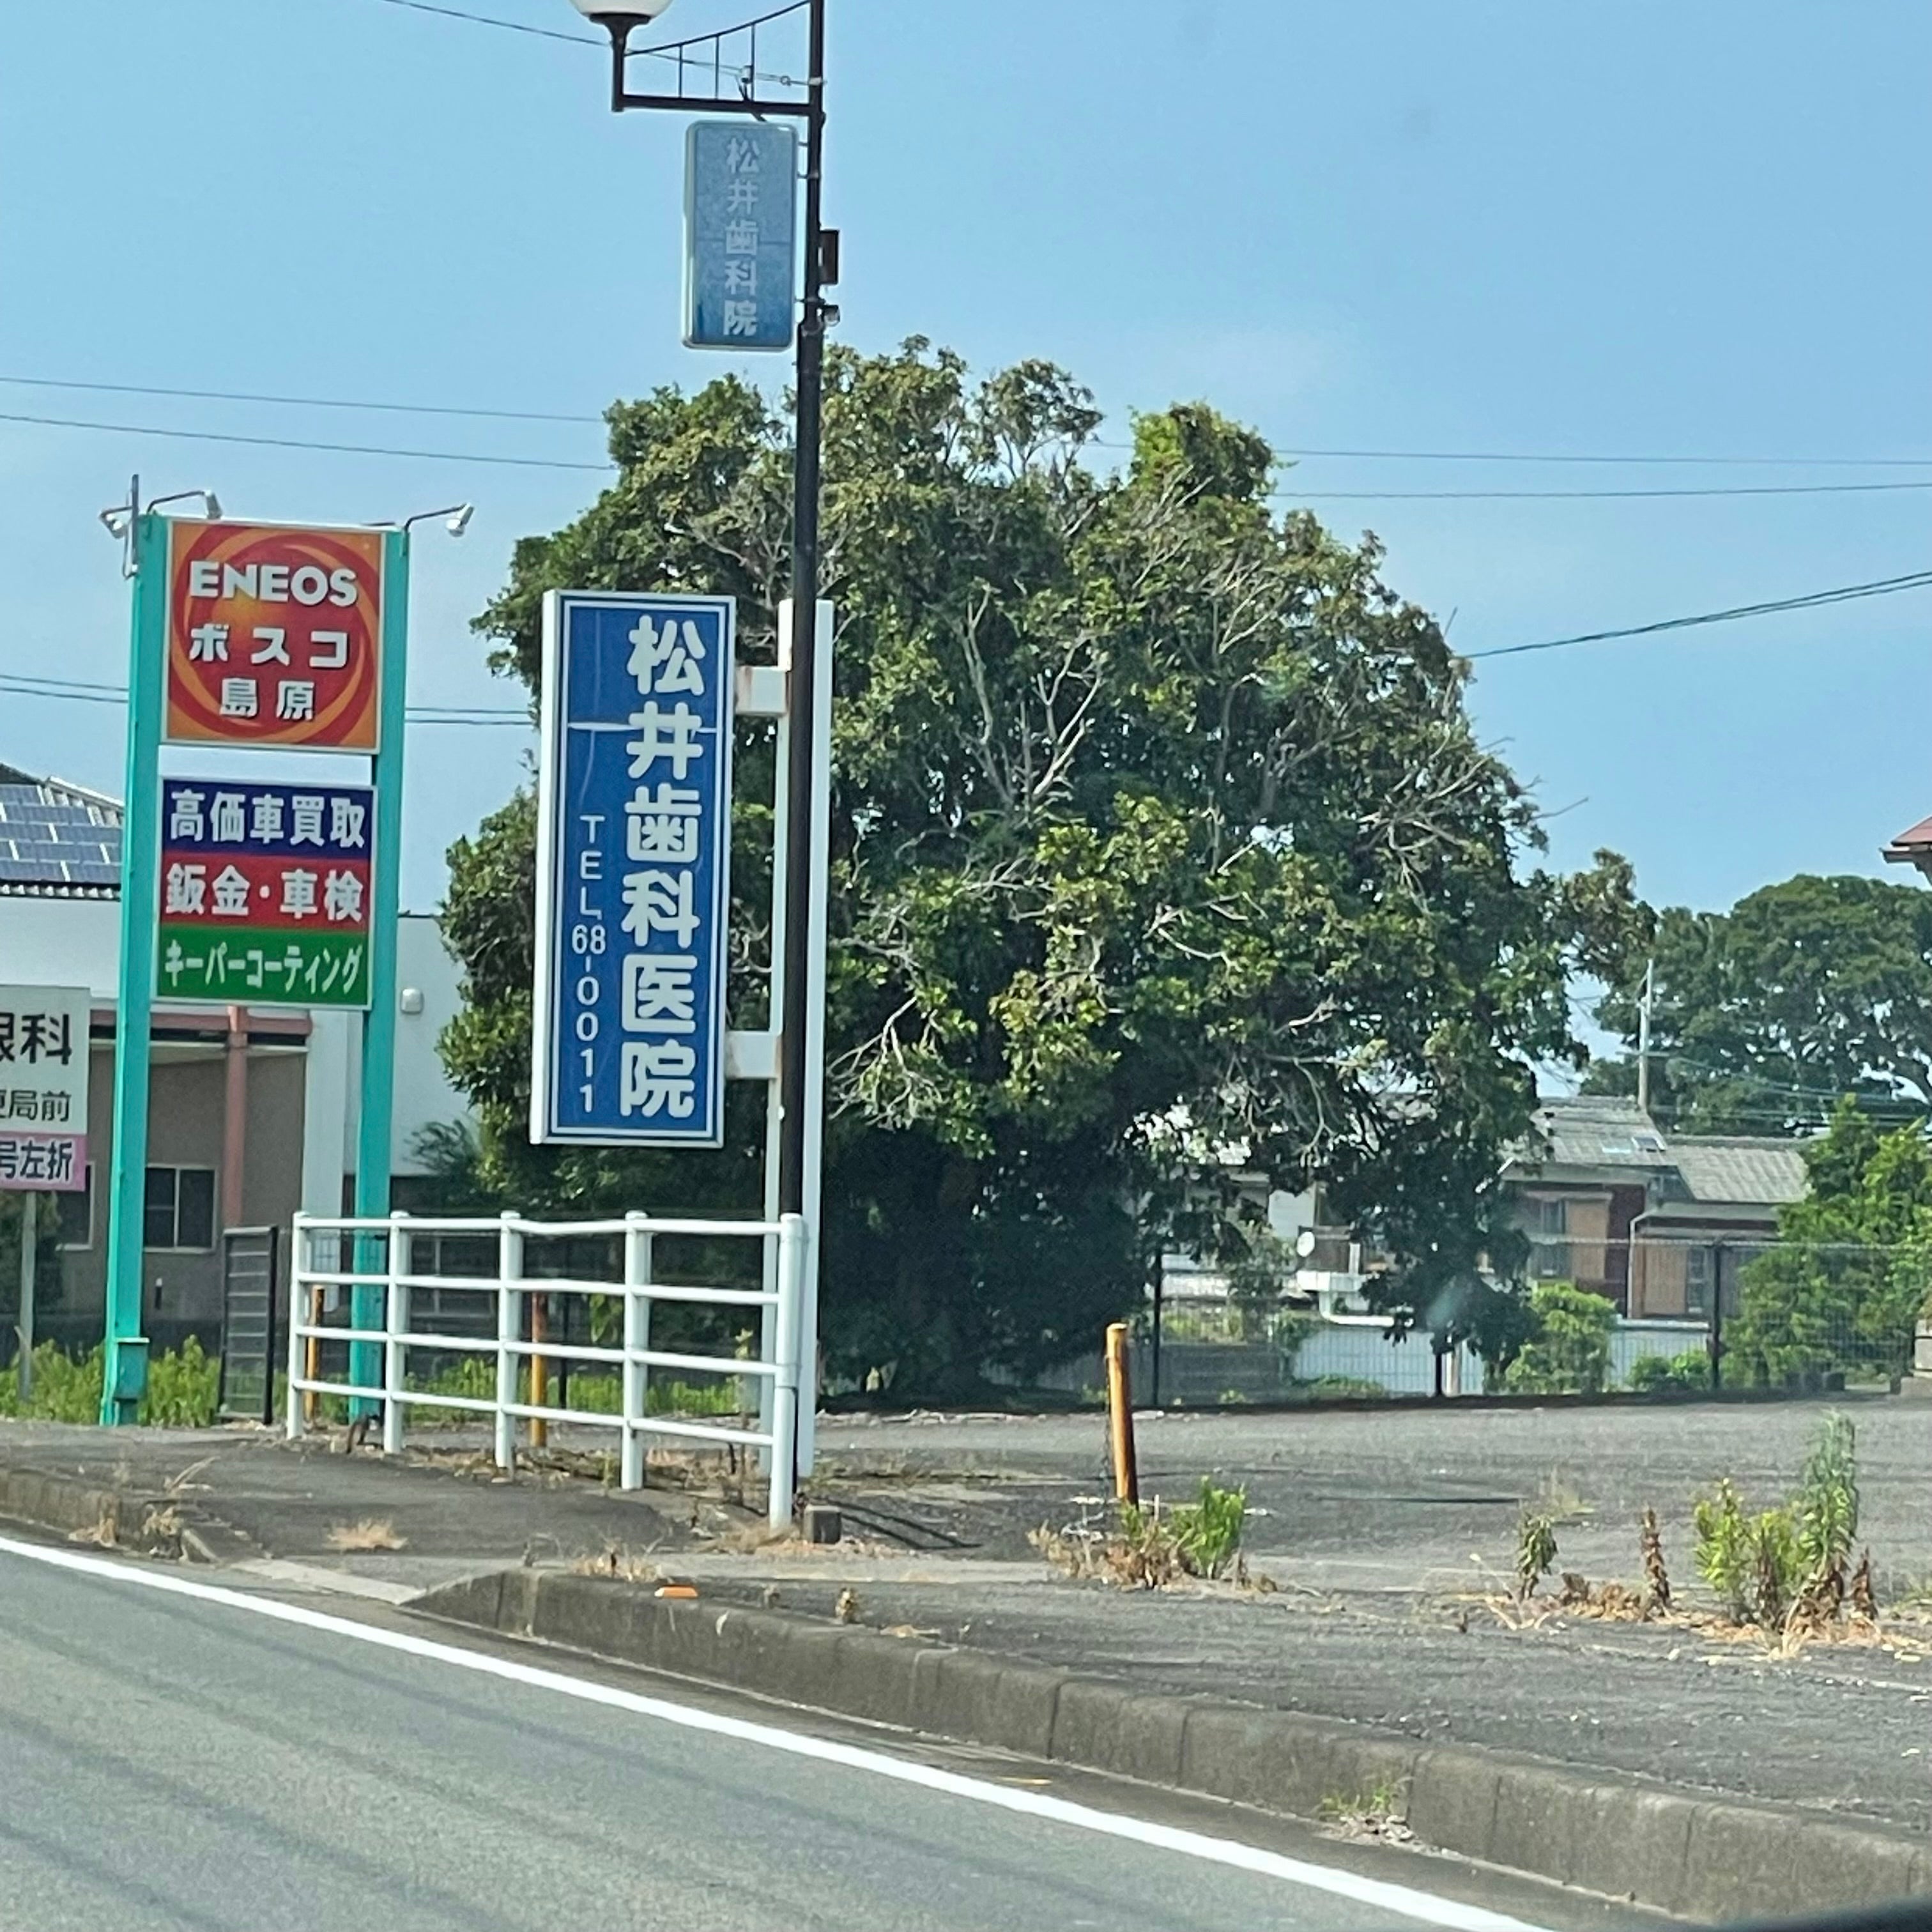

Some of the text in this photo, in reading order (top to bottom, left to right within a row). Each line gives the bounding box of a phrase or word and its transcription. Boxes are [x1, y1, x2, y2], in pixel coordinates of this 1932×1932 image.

[723, 137, 760, 337] 松井歯科院
[190, 560, 358, 607] ENEOS
[189, 623, 349, 668] ボスコ
[219, 677, 315, 721] 島原
[170, 788, 365, 848] 高価車買取
[619, 615, 705, 1118] 松井歯科医院
[164, 939, 363, 994] キーパーコーティング
[0, 1089, 72, 1122] 局前
